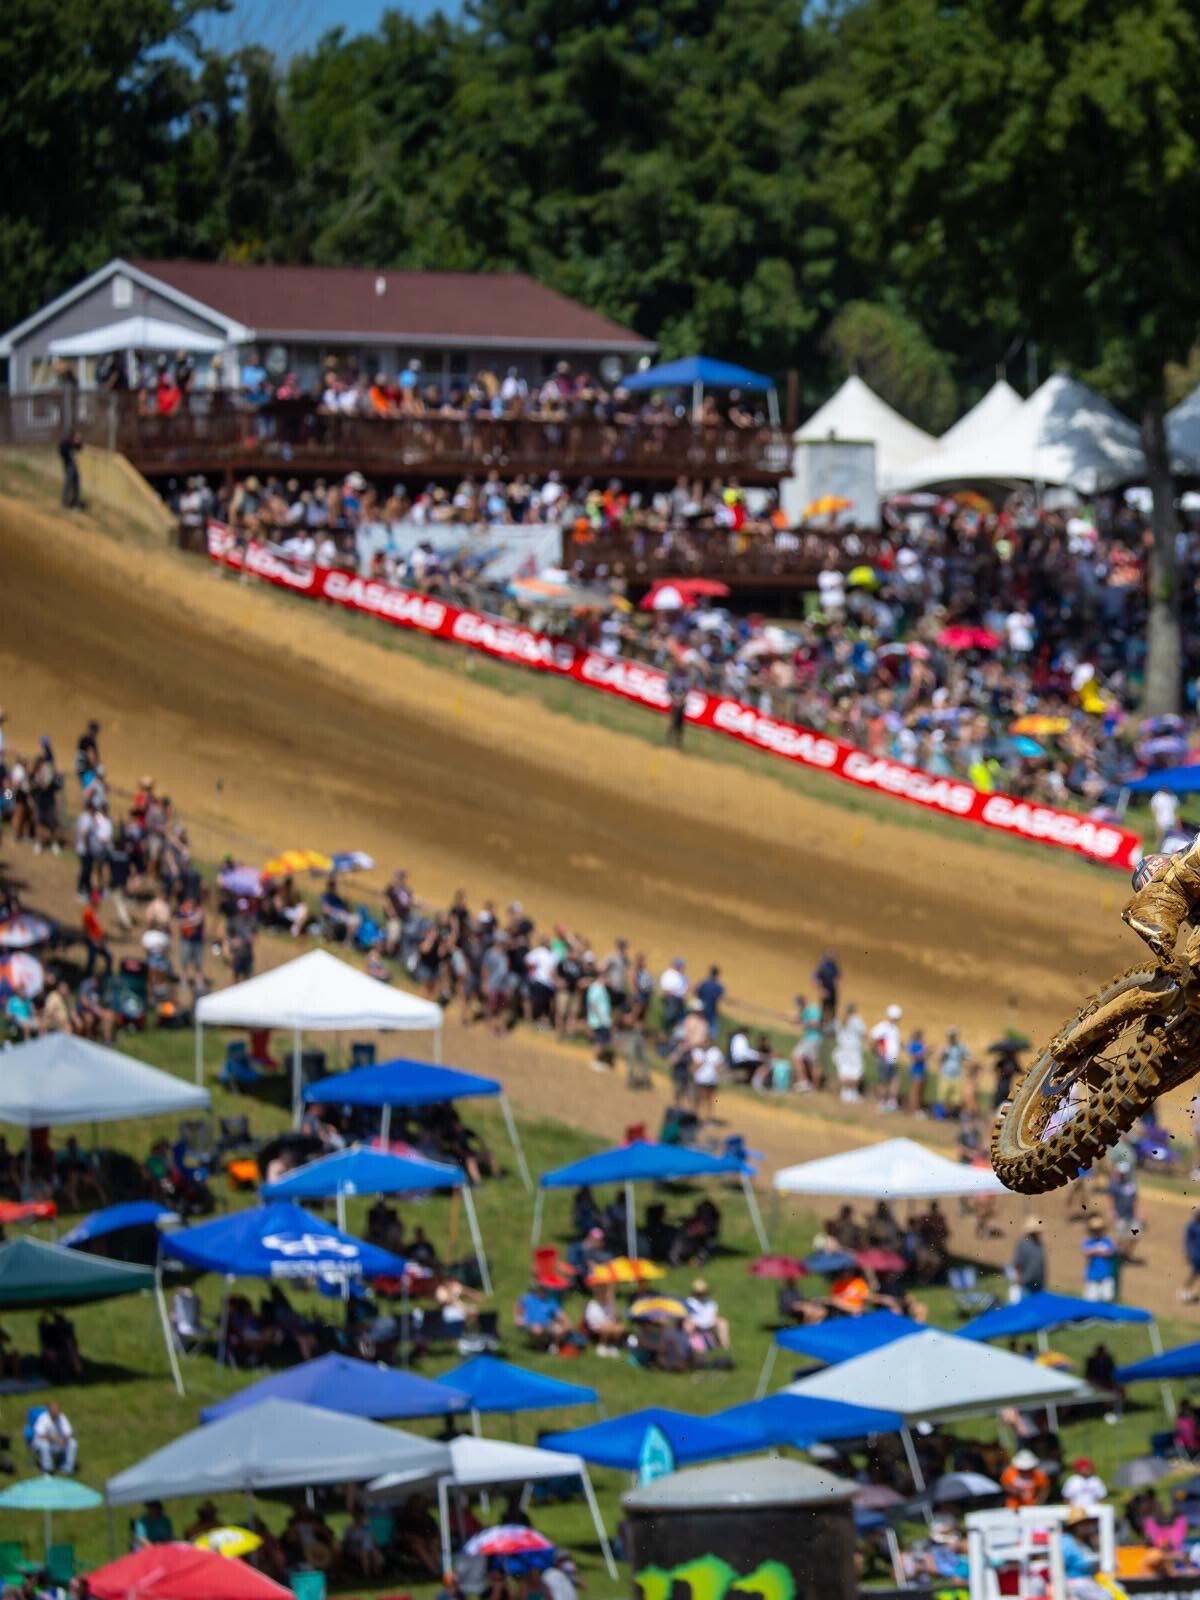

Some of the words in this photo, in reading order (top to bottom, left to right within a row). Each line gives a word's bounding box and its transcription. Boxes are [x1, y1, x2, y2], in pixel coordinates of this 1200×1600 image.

[713, 698, 838, 768] GASGAS
[843, 751, 975, 816] GASGAS
[982, 795, 1124, 858] GASGAS
